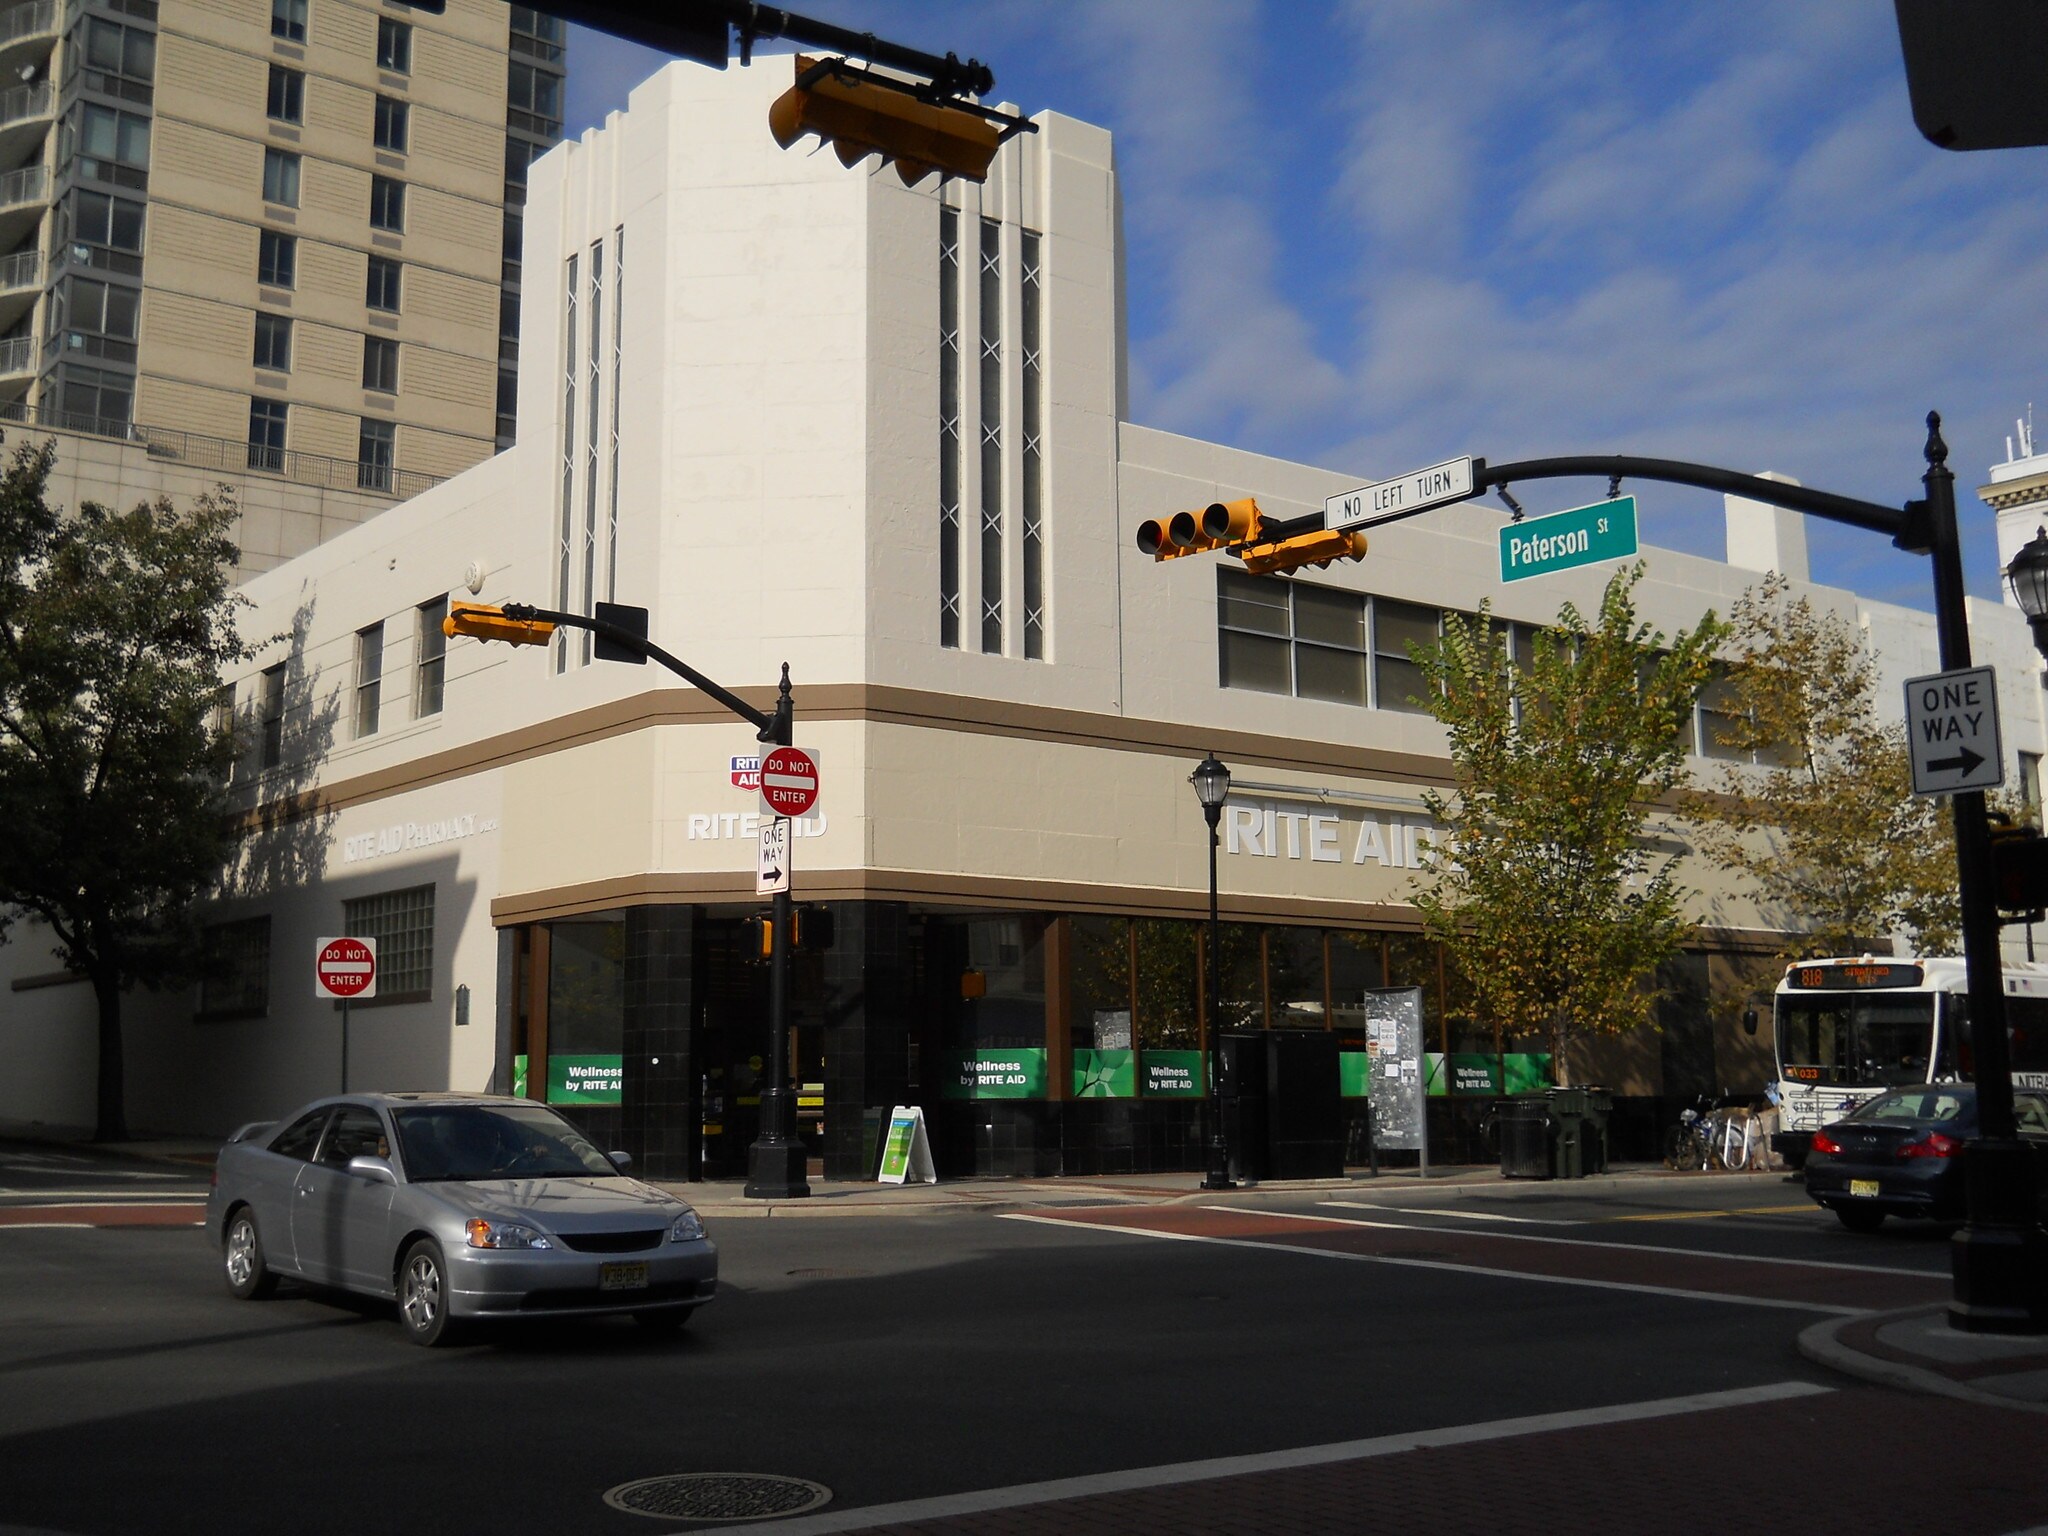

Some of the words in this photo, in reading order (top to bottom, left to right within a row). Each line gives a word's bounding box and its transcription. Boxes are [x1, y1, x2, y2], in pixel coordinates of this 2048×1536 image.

[1343, 497, 1362, 519] NO
[1374, 485, 1404, 511] LEFT
[1417, 470, 1451, 499] TURN
[1509, 528, 1589, 567] Paterson
[1597, 517, 1609, 534] St
[1923, 681, 1980, 712] ONE
[1922, 711, 1983, 743] WAY
[769, 759, 783, 771] DO
[789, 761, 810, 774] NOT
[773, 790, 806, 804] ENTER
[687, 812, 760, 840] RITE
[764, 828, 784, 845] ONE
[1226, 799, 1342, 863] RITE
[1353, 812, 1437, 870] AID
[344, 831, 376, 864] RITE
[377, 825, 403, 857] AID
[763, 846, 784, 863] WAY
[326, 949, 340, 960] DO
[346, 949, 367, 960] NOT
[329, 975, 363, 986] ENTER
[1801, 968, 1823, 986] 818
[569, 1066, 622, 1077] Wellness
[963, 1061, 1021, 1071] Wellness
[1150, 1067, 1189, 1076] Wellness
[960, 1075, 975, 1086] by
[978, 1075, 1004, 1084] RITE
[1006, 1075, 1026, 1084] AID
[1800, 1069, 1818, 1079] 033
[565, 1081, 580, 1091] by
[583, 1081, 608, 1090] RITE
[610, 1081, 622, 1090] AI
[1149, 1080, 1159, 1090] by
[1160, 1080, 1178, 1088] RITE
[1179, 1080, 1192, 1088] AID
[1456, 1080, 1464, 1089] by
[1465, 1080, 1479, 1088] RITE
[1480, 1080, 1491, 1088] AID
